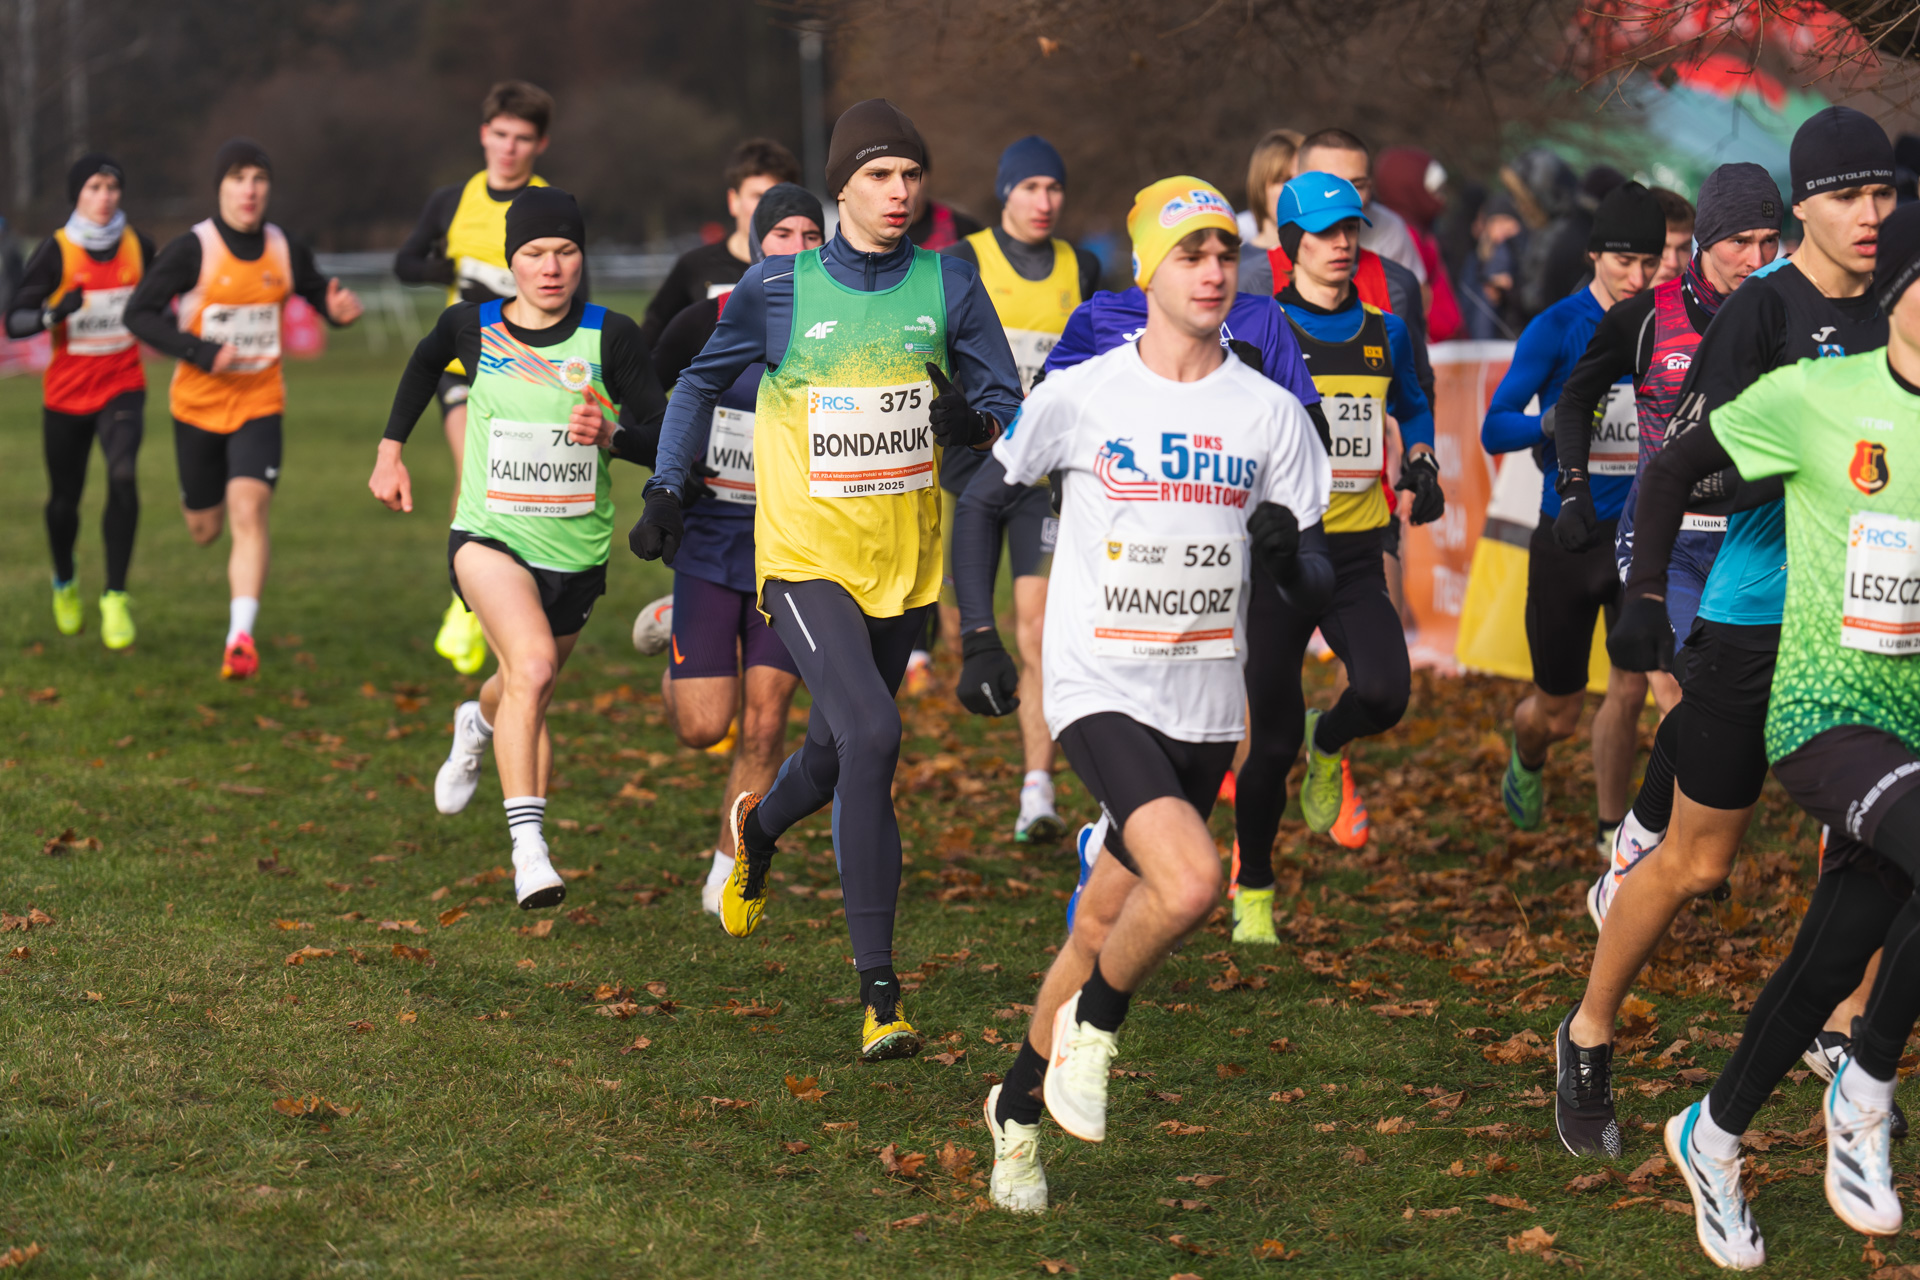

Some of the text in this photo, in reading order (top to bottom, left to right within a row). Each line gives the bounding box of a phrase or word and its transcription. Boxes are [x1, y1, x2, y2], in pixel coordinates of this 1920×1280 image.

[1816, 169, 1893, 187] RUN YOUR WAY
[804, 320, 838, 339] 4F
[880, 388, 922, 413] 375
[1338, 403, 1372, 421] 215
[813, 425, 929, 457] BONDARUK
[1193, 434, 1223, 450] UKS
[1161, 432, 1257, 489] 5 PLUS
[491, 458, 592, 482] KALINOWSKI
[843, 480, 905, 494] LUBIN 2025
[514, 505, 541, 513] LUBIN
[1692, 519, 1721, 528] LUBIN
[1184, 543, 1231, 567] 526
[1104, 584, 1234, 616] WANGLORZ
[1132, 645, 1199, 656] LUBIN 2025
[1879, 638, 1911, 648] LUBIN
